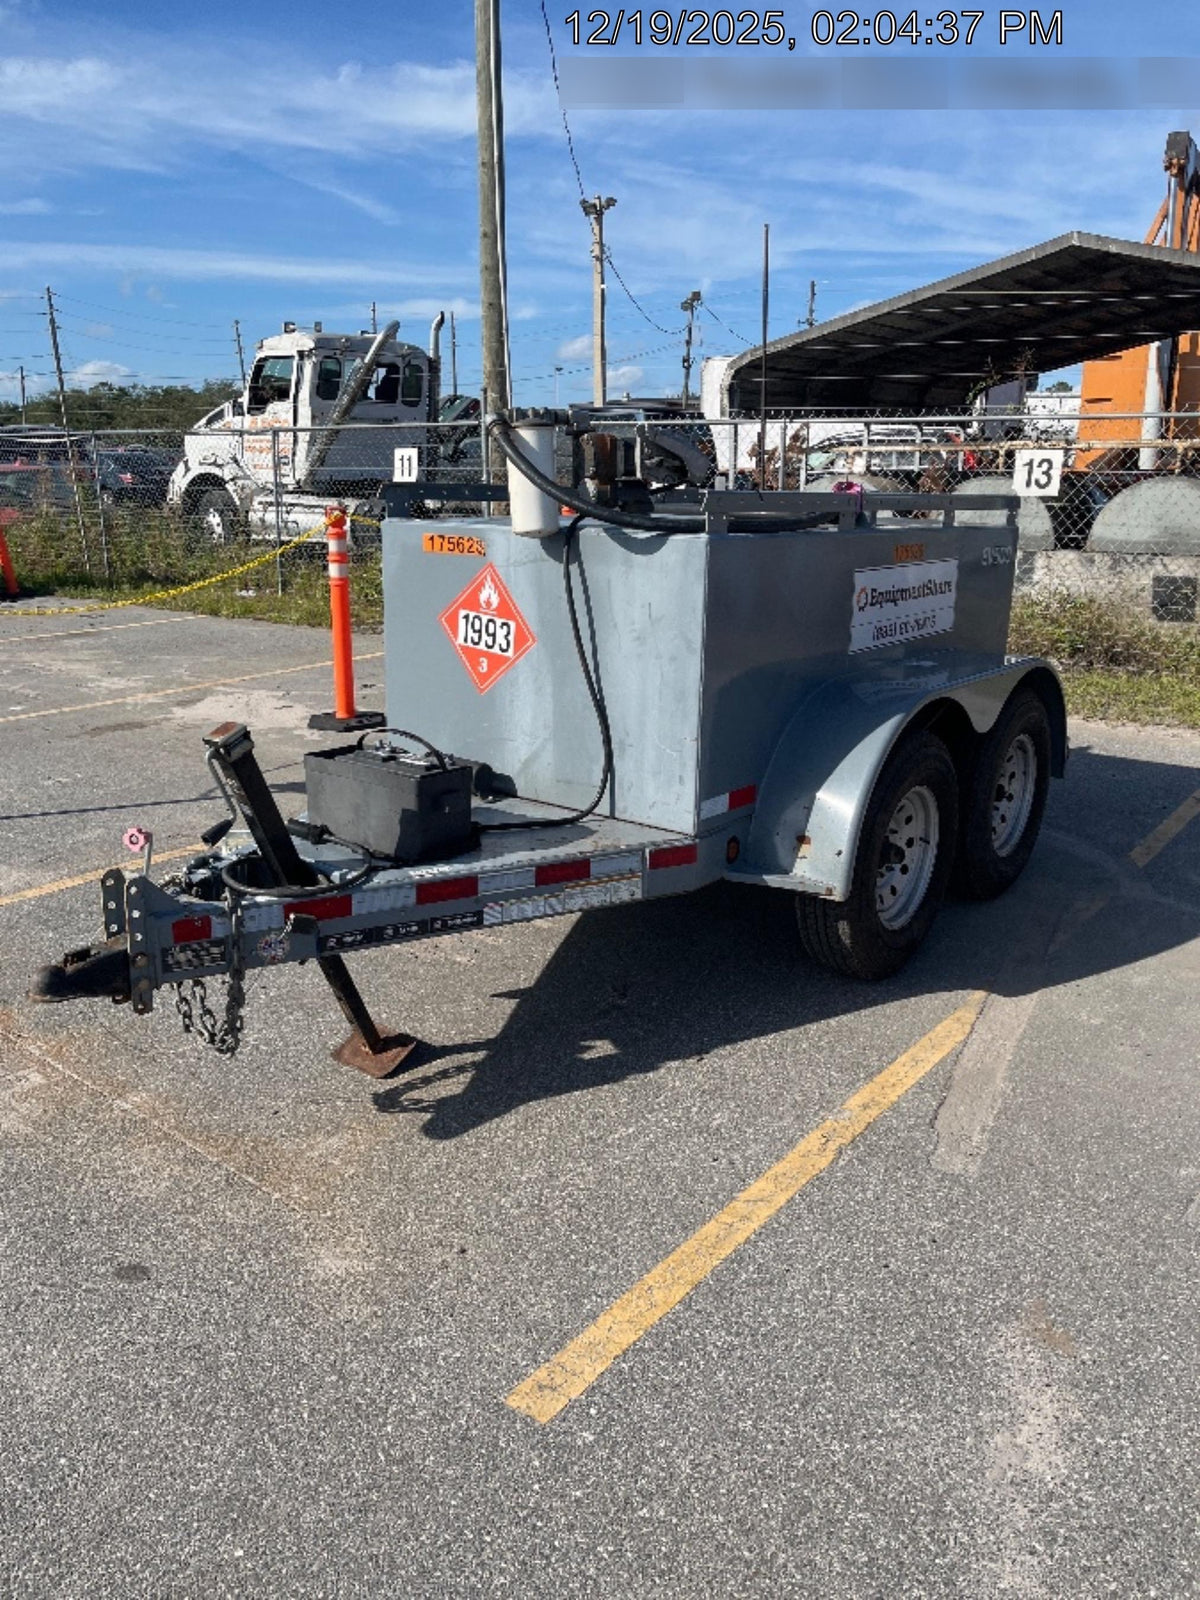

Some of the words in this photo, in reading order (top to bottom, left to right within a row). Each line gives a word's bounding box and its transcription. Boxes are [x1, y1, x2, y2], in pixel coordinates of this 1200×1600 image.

[398, 454, 412, 477] 11
[1022, 458, 1054, 489] 13
[461, 612, 512, 653] 1993
[477, 656, 488, 673] 3
